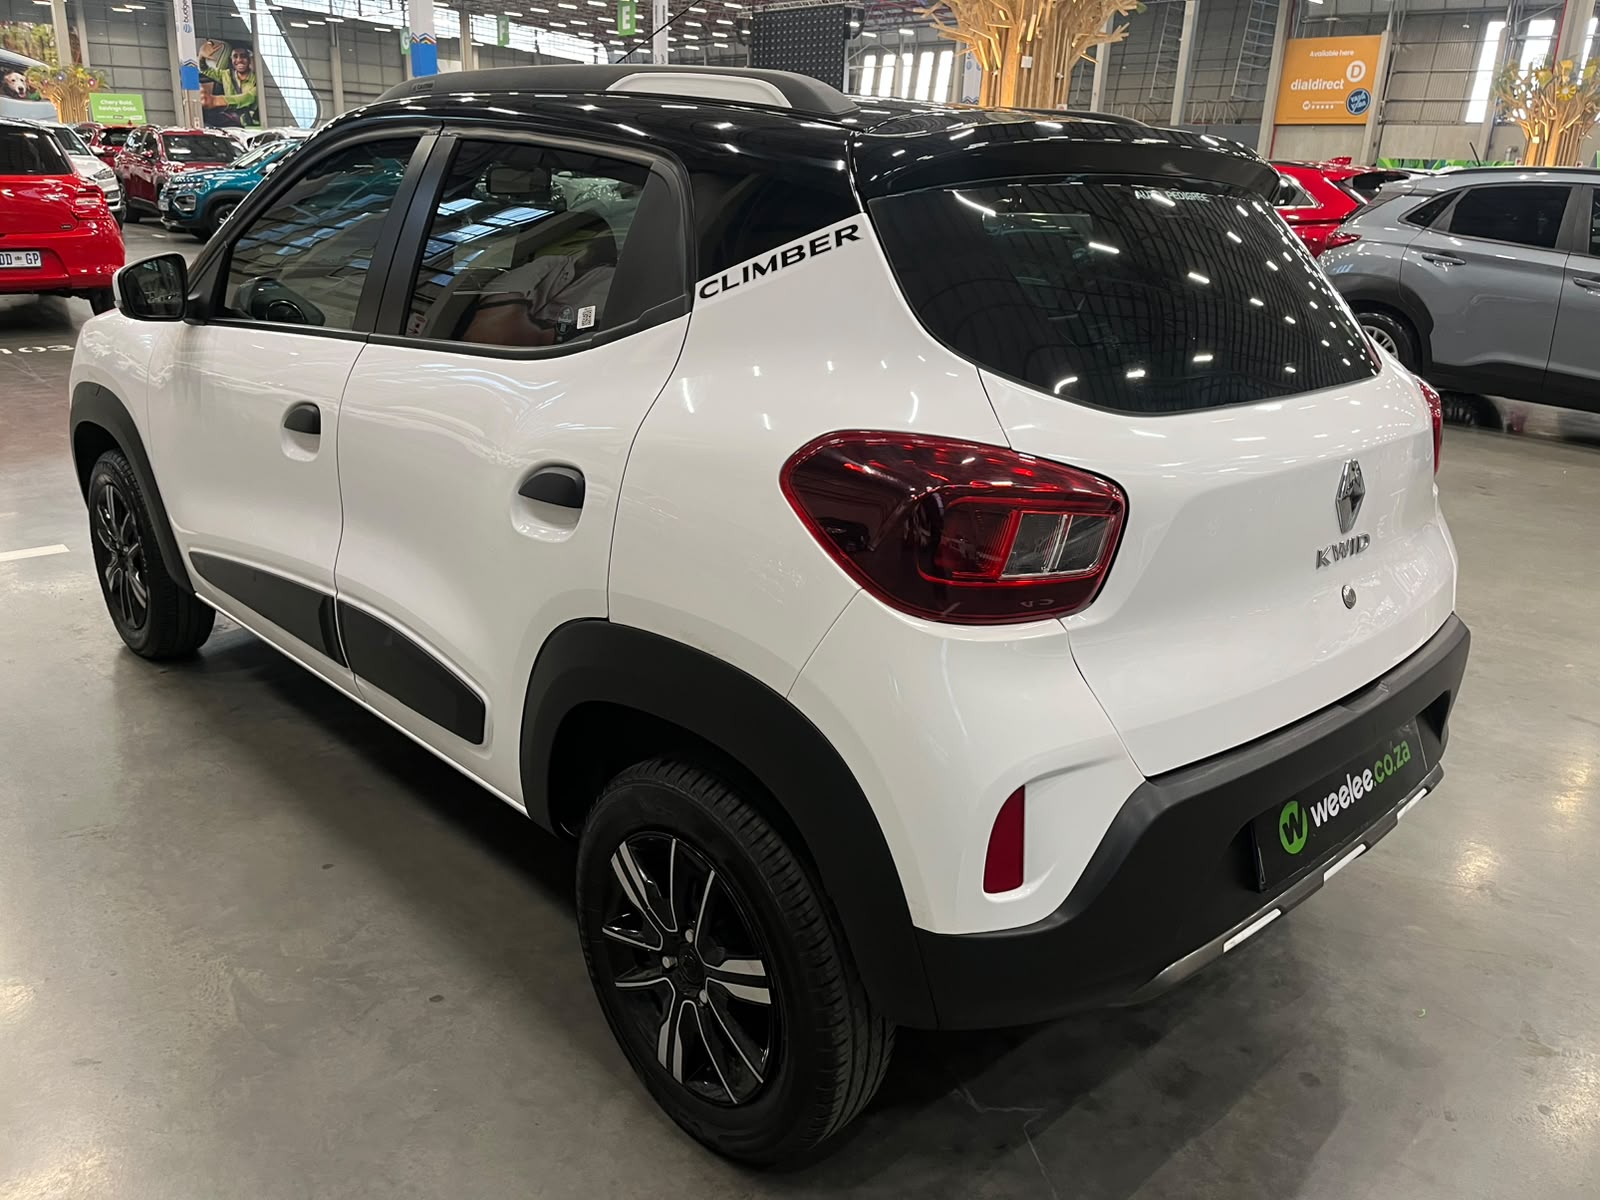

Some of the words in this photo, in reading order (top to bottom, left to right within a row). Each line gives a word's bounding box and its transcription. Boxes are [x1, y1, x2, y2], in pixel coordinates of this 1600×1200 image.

[622, 5, 631, 30] E
[400, 31, 410, 50] G
[1290, 78, 1345, 90] dialdirect
[25, 252, 39, 265] GP
[699, 224, 861, 299] CLIMBER
[1315, 533, 1371, 569] KWID
[1310, 740, 1412, 828] weelee.co.za
